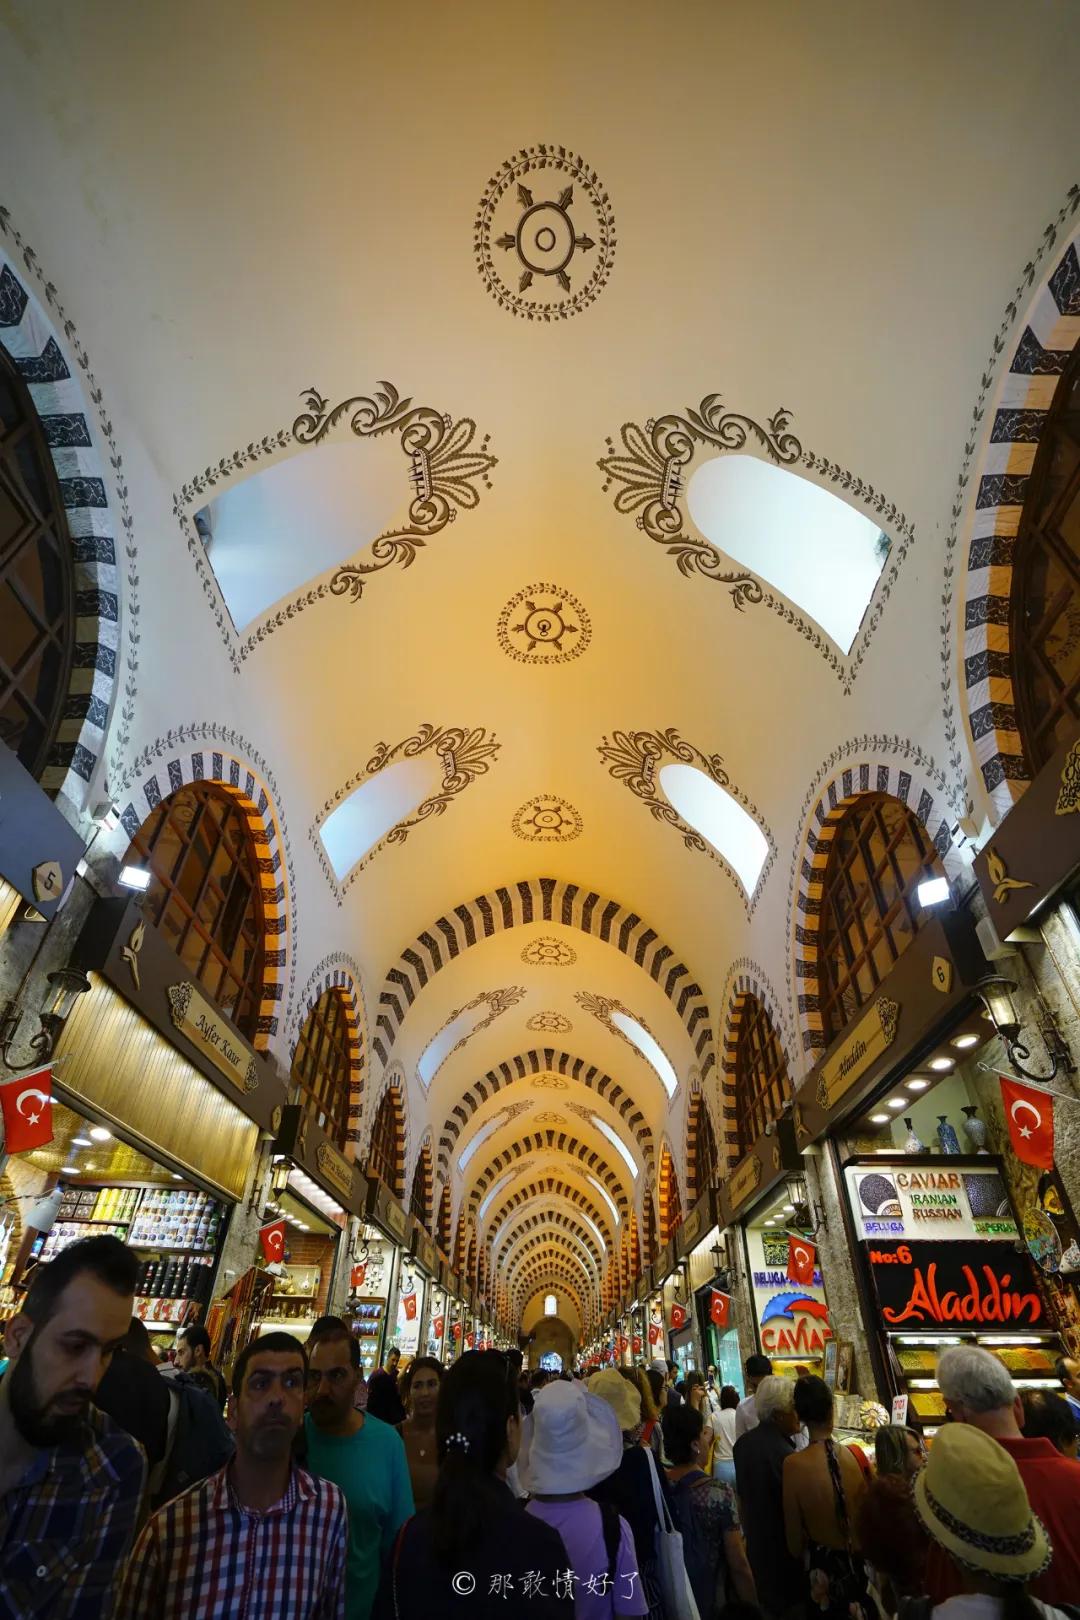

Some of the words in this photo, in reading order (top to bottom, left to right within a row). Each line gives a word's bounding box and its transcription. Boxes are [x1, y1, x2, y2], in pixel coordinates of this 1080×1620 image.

[43, 870, 56, 891] 5
[936, 966, 945, 983] 6
[196, 1014, 221, 1046] Ayfer
[839, 1040, 867, 1080] Aladdin
[897, 1173, 960, 1188] CAVIAR
[911, 1194, 957, 1205] IRANIAN
[912, 1208, 962, 1219] RUSSIAN
[865, 1222, 905, 1232] BELUGA
[882, 1262, 1041, 1324] Aladdin
